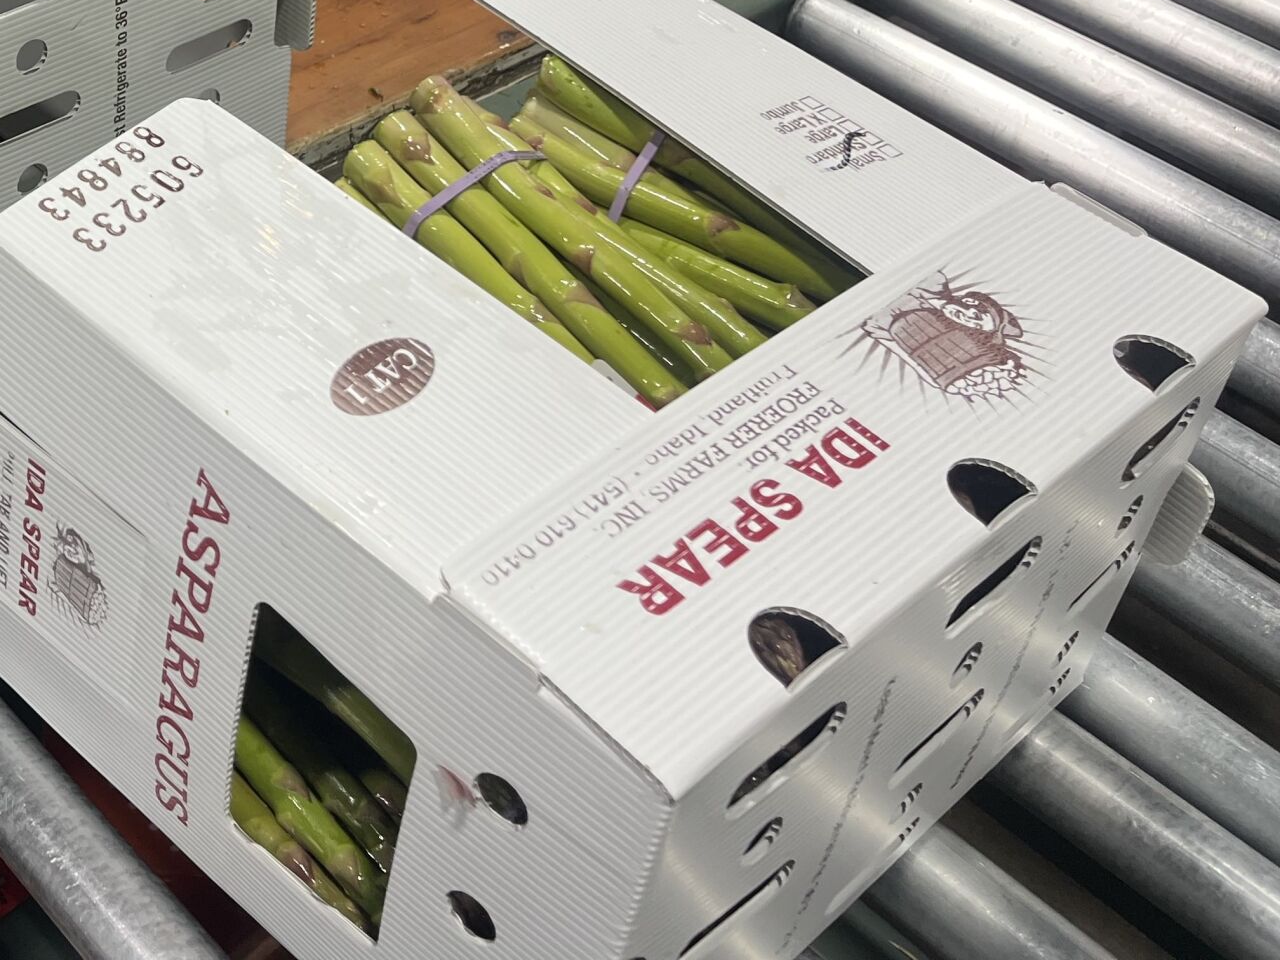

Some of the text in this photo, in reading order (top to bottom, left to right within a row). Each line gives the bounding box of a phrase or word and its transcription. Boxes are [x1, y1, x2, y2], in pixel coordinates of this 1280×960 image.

[116, 31, 128, 48] to
[114, 47, 130, 125] Refrigerate
[759, 100, 806, 121] Jumbo
[774, 112, 828, 135] X Large
[804, 125, 846, 144] Large
[37, 126, 166, 222] 884843
[72, 155, 204, 253] 605233
[364, 348, 418, 394] CAT
[723, 380, 821, 450] FROERER
[771, 397, 846, 453] Packed
[643, 423, 711, 466] Idaho
[0, 493, 12, 521] TAB
[573, 475, 629, 520] (541)
[615, 416, 891, 617] IDA SPEAR
[17, 457, 47, 617] IDA SPEAR
[153, 467, 232, 827] ASPARAGUS
